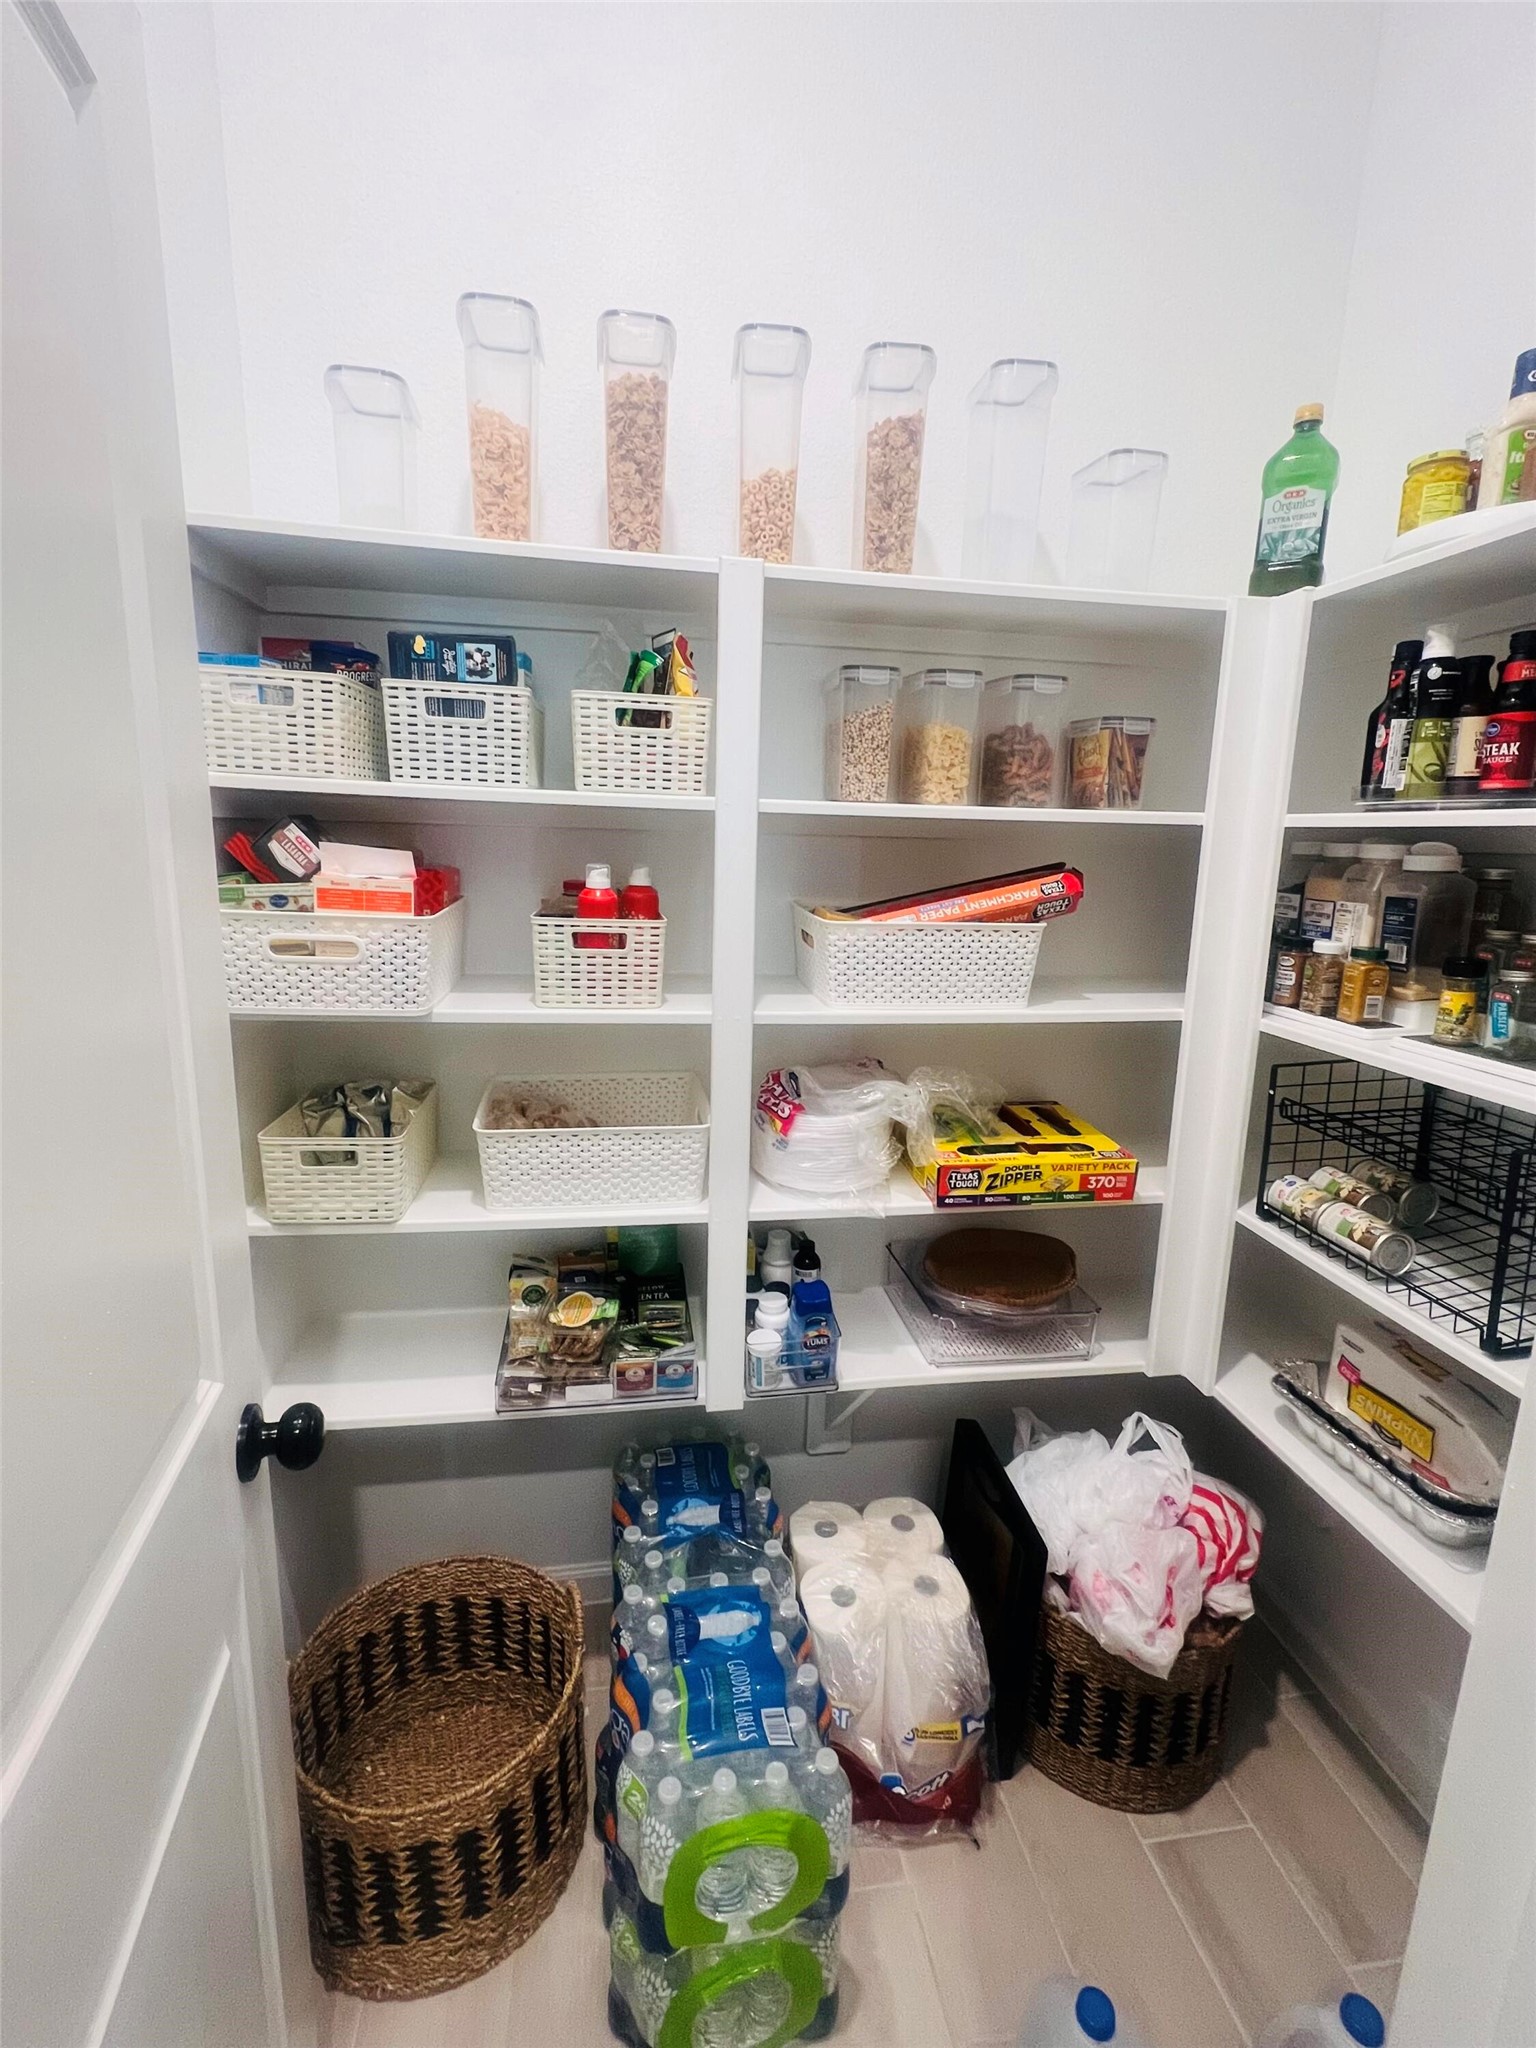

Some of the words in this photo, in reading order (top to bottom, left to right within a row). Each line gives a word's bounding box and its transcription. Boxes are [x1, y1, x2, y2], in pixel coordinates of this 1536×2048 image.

[1272, 498, 1316, 514] Organics
[1267, 516, 1290, 524] EXTRA
[1292, 512, 1317, 520] VIRGIN
[1482, 741, 1520, 759] STEAK
[1482, 756, 1513, 764] SAUCE
[281, 839, 308, 866] LASAGNA
[1041, 881, 1063, 889] TOUGH
[1044, 886, 1065, 896] TEXAS
[960, 889, 1038, 912] PARCHMENT
[1037, 898, 1071, 911] TOUGH
[919, 906, 960, 921] PAPER
[1036, 903, 1067, 917] TEXAS
[1498, 1002, 1509, 1034] PARSLEY
[1004, 1164, 1040, 1172] DOUBLE
[1051, 1163, 1099, 1172] VARIETY
[1102, 1162, 1131, 1170] PACK
[951, 1172, 979, 1180] TEXAS
[985, 1170, 1043, 1192] ZIPPER
[1087, 1176, 1115, 1189] 370
[950, 1179, 979, 1188] TOUGH
[806, 1337, 829, 1347] TUMS
[1356, 1394, 1424, 1448] NAPKINS
[727, 1659, 752, 1705] GOODBYE
[734, 1705, 759, 1742] LABELS
